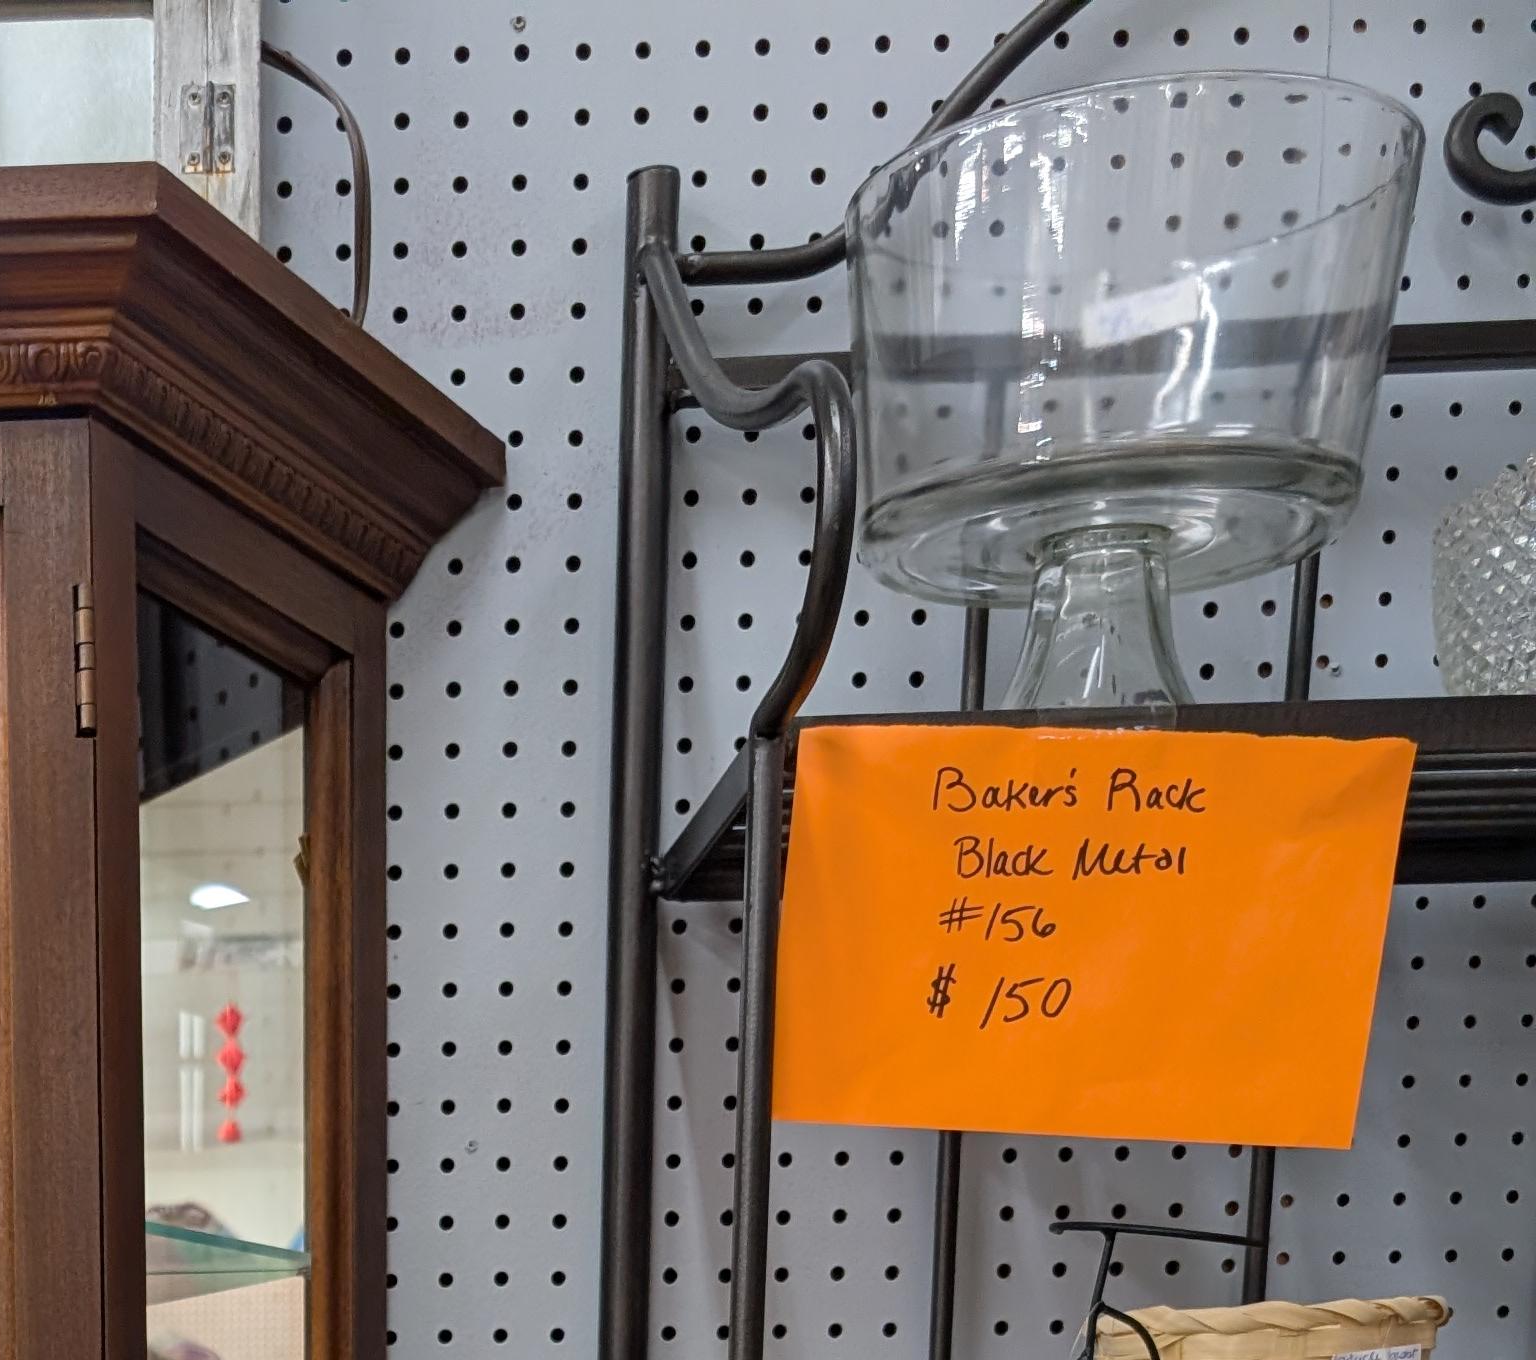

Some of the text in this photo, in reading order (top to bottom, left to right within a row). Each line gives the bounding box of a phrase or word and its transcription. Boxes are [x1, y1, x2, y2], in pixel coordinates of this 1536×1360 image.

[932, 766, 1207, 814] Baker's Rack
[954, 835, 1186, 880] Black Metal
[939, 896, 1057, 942] #156
